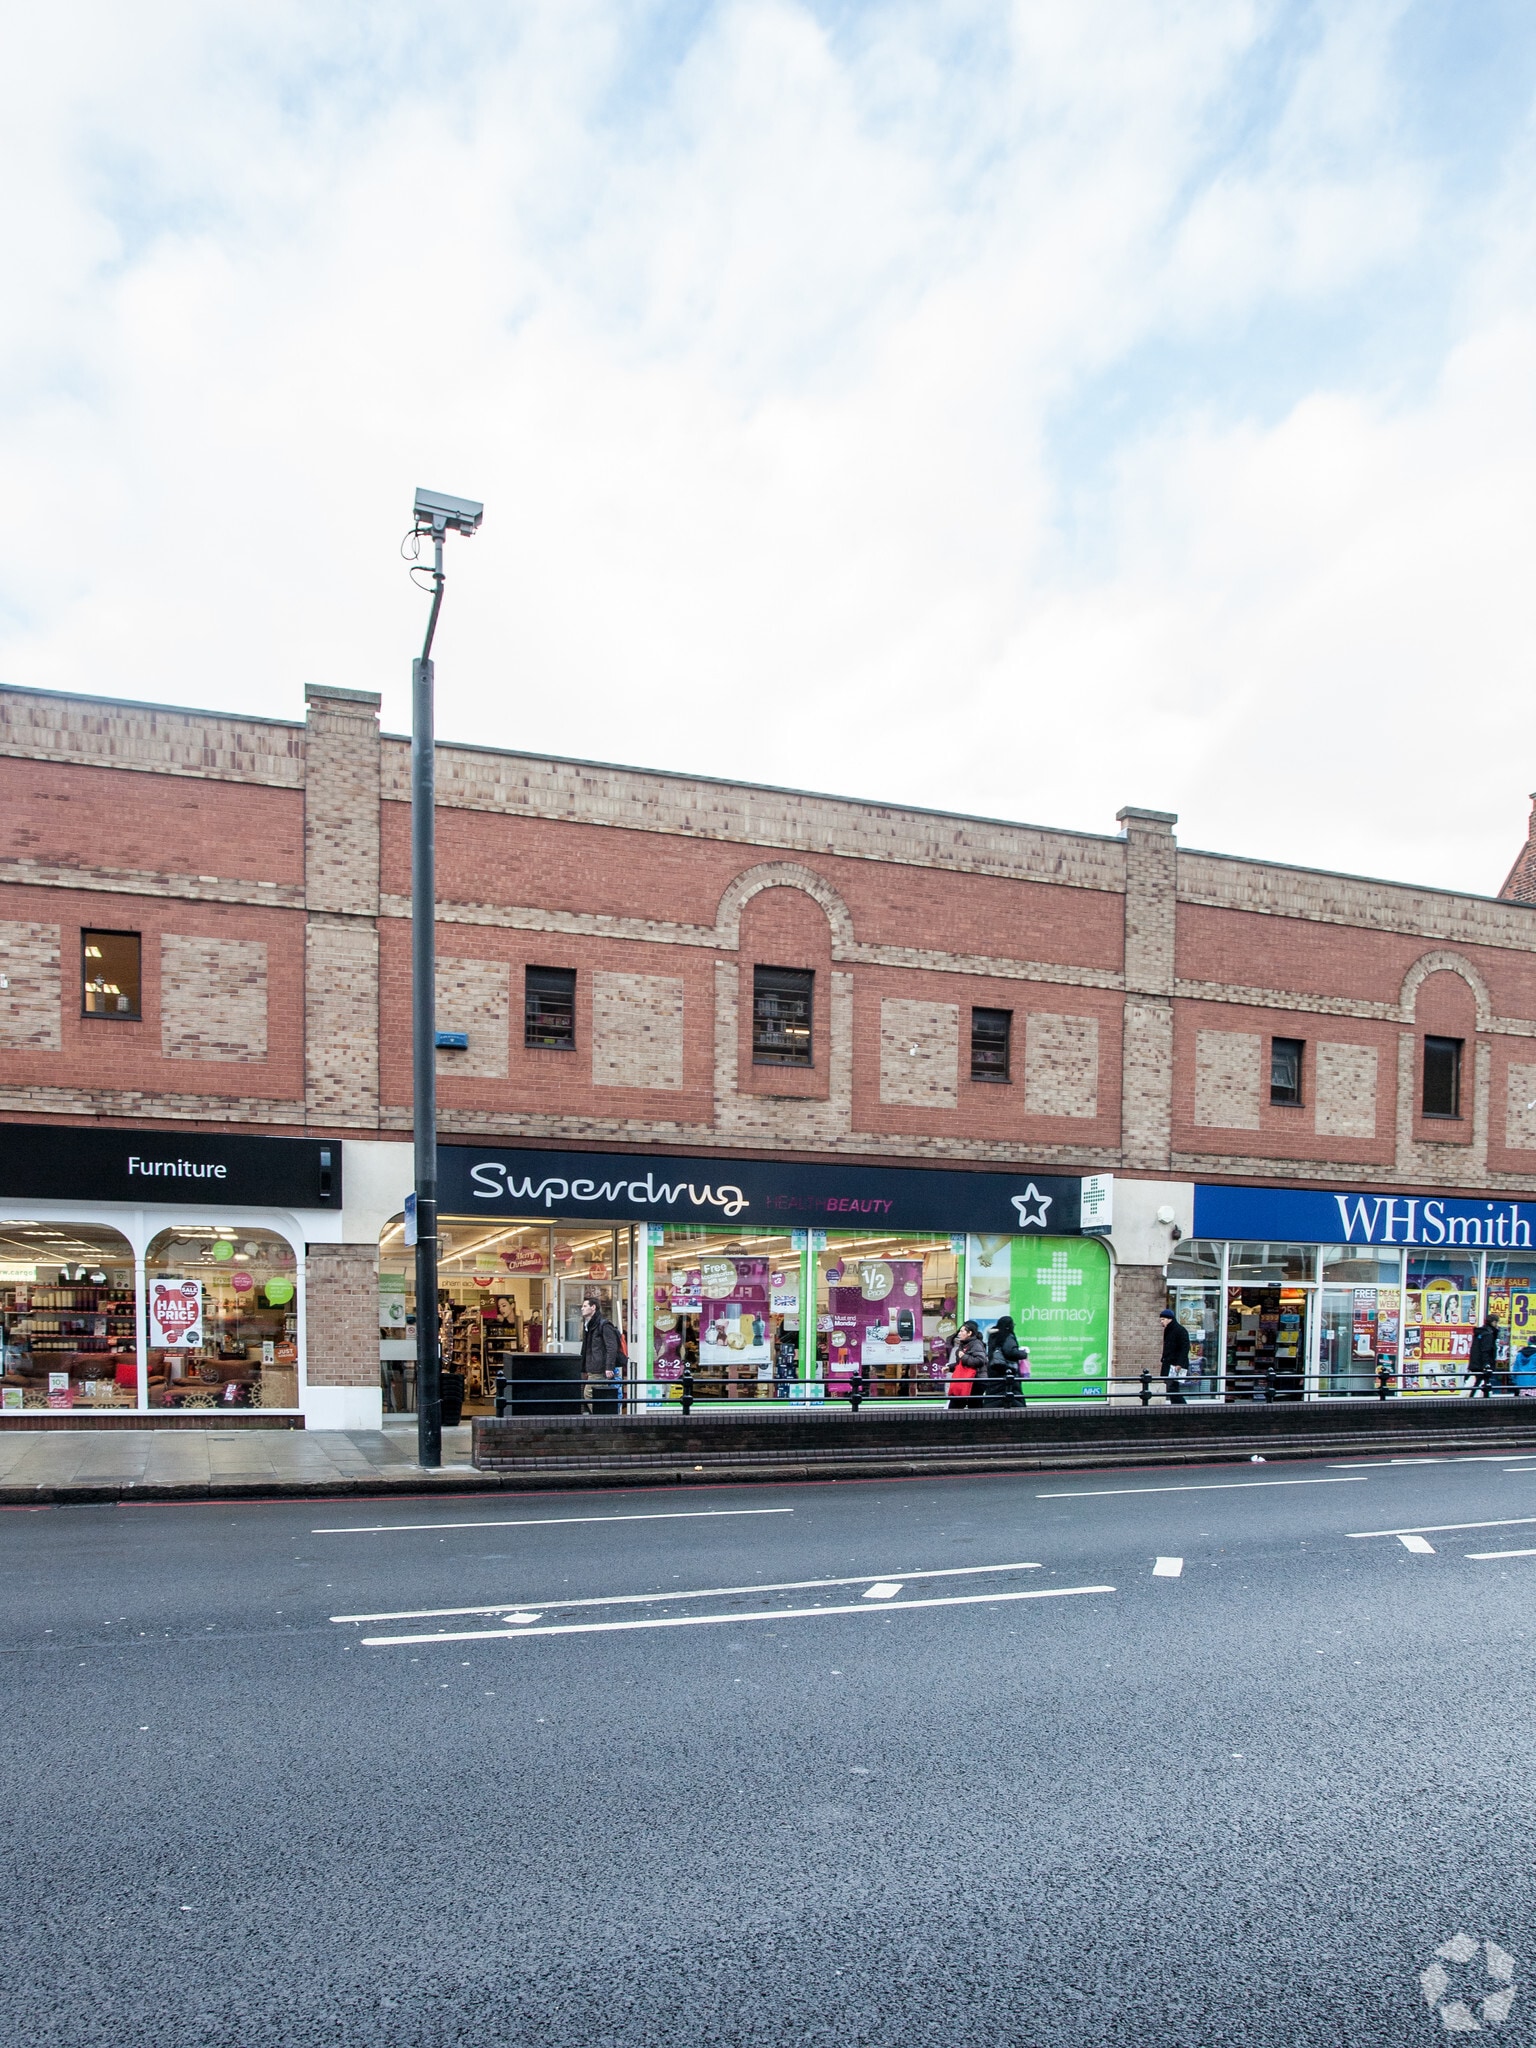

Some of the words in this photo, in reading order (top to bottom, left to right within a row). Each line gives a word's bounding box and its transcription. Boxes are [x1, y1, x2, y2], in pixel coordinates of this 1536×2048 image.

[128, 1156, 227, 1179] Furniture
[470, 1162, 750, 1217] Superdrug
[1334, 1194, 1533, 1248] WHSmith
[703, 1263, 727, 1274] Free
[861, 1268, 886, 1290] 1/2
[1354, 1289, 1376, 1299] FREE
[157, 1300, 196, 1311] HALF
[1021, 1304, 1096, 1325] pharmacy
[1514, 1295, 1529, 1327] 3
[157, 1310, 196, 1320] PRICE
[1423, 1338, 1451, 1354] SALE
[1083, 1387, 1101, 1395] NHS
